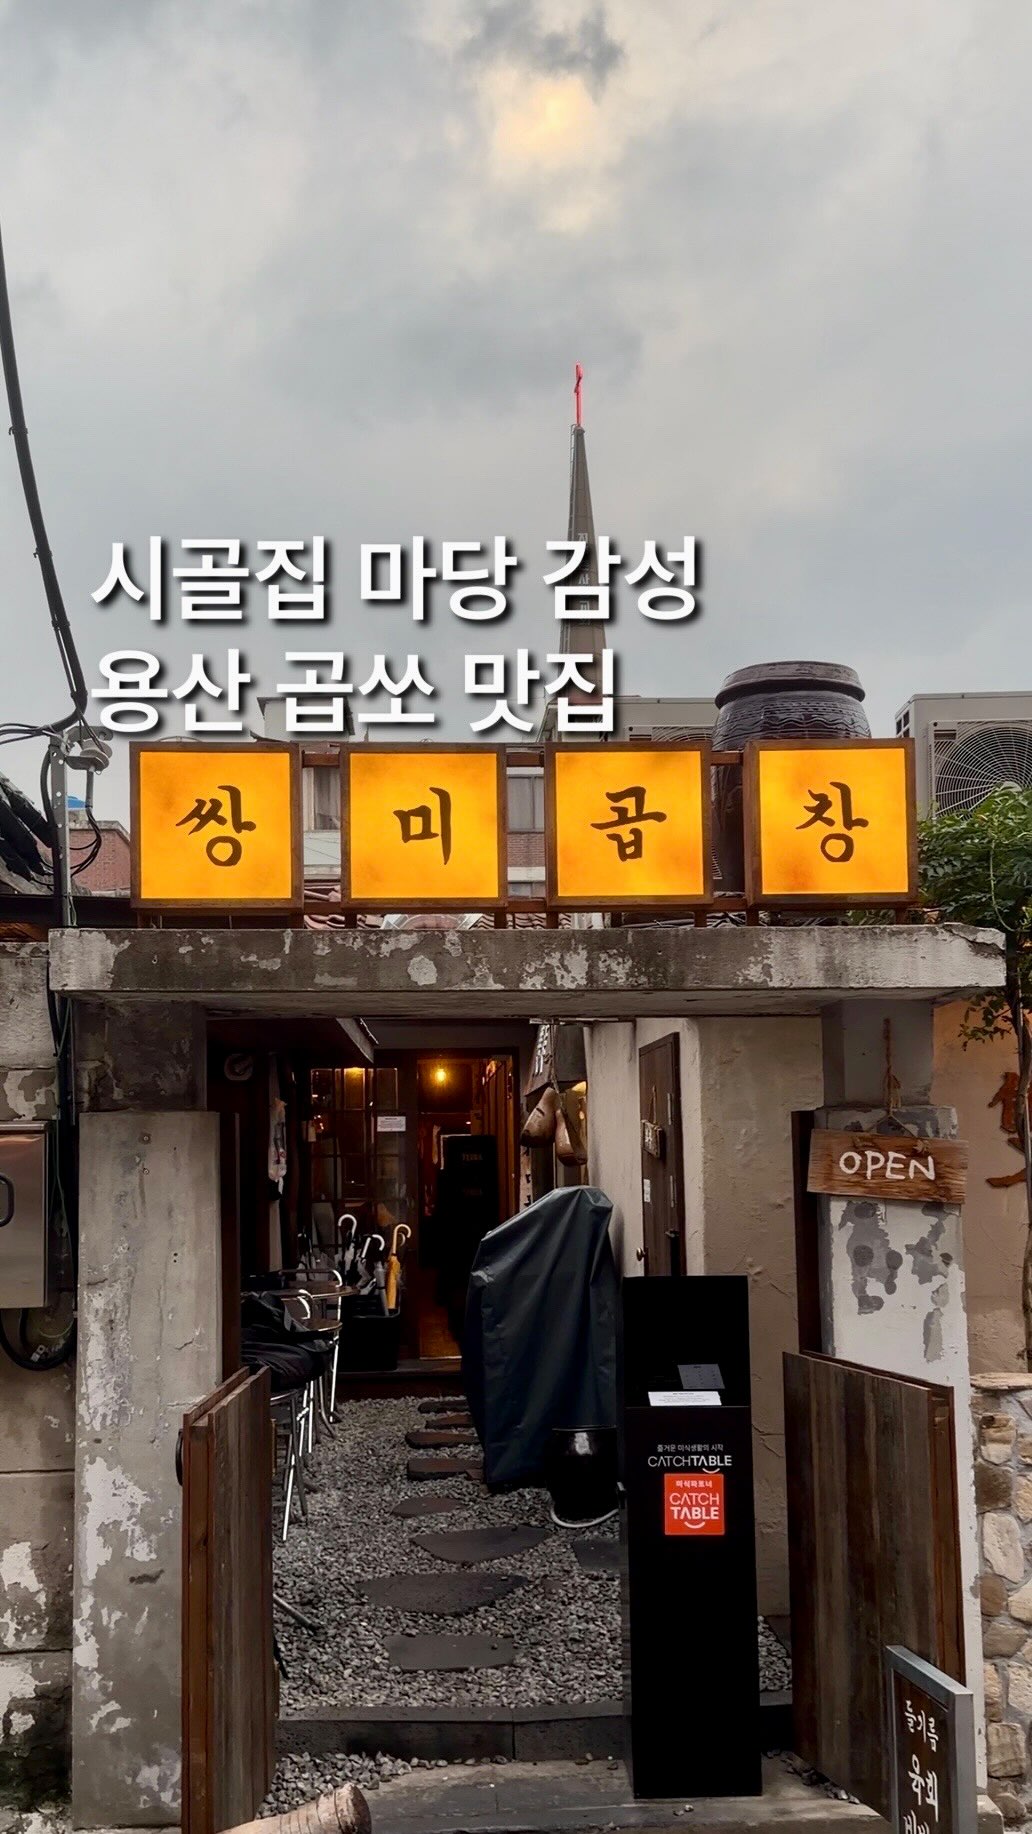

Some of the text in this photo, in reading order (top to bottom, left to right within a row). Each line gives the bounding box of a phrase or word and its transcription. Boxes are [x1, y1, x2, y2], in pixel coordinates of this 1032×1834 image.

[838, 1150, 936, 1181] OPEN
[657, 1444, 676, 1453] 즐거운
[711, 1444, 724, 1452] 시작
[647, 1455, 733, 1467] CATCHTABLE
[675, 1479, 713, 1489] 미식파트너
[669, 1492, 720, 1506] CATCH
[670, 1506, 720, 1520] TABLE
[903, 1699, 940, 1753] 들기름
[907, 1753, 939, 1824] 육회
